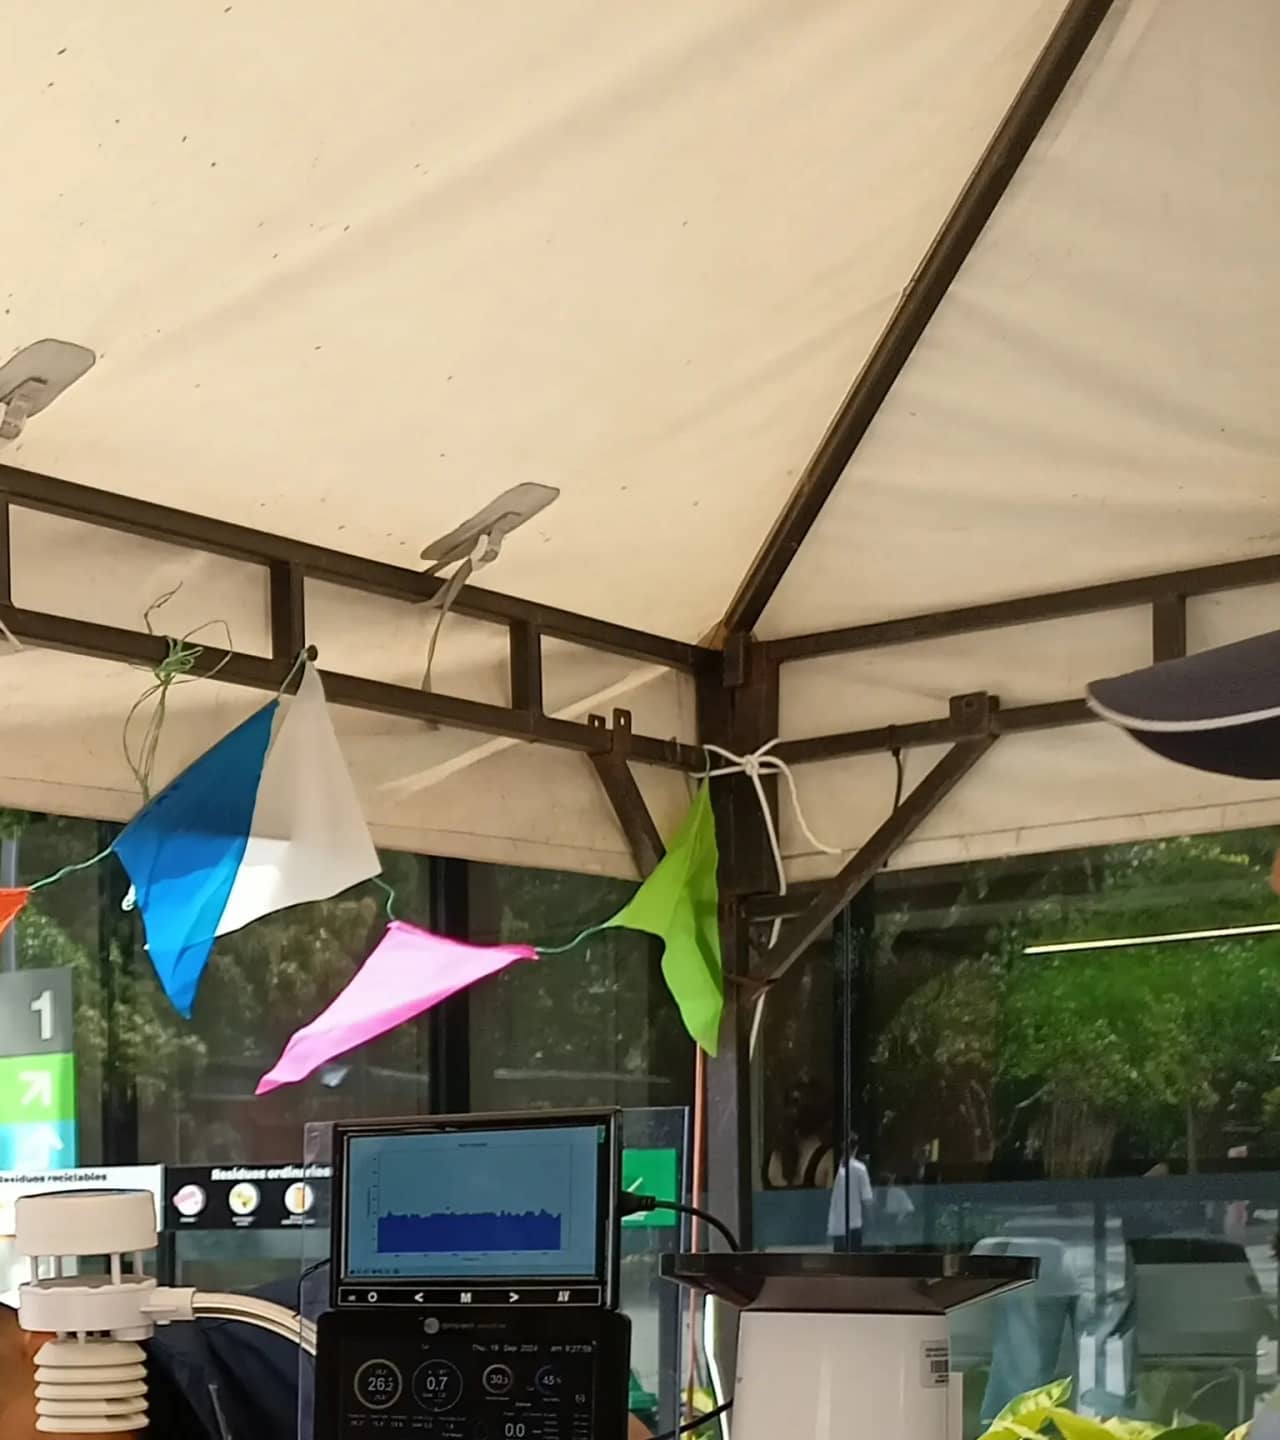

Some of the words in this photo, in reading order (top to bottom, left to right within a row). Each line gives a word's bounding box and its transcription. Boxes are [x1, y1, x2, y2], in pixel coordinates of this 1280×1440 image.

[30, 989, 54, 1041] 1
[47, 1172, 108, 1182] reciclables
[211, 1167, 266, 1181] Residuos
[267, 1164, 333, 1179] ordinarios
